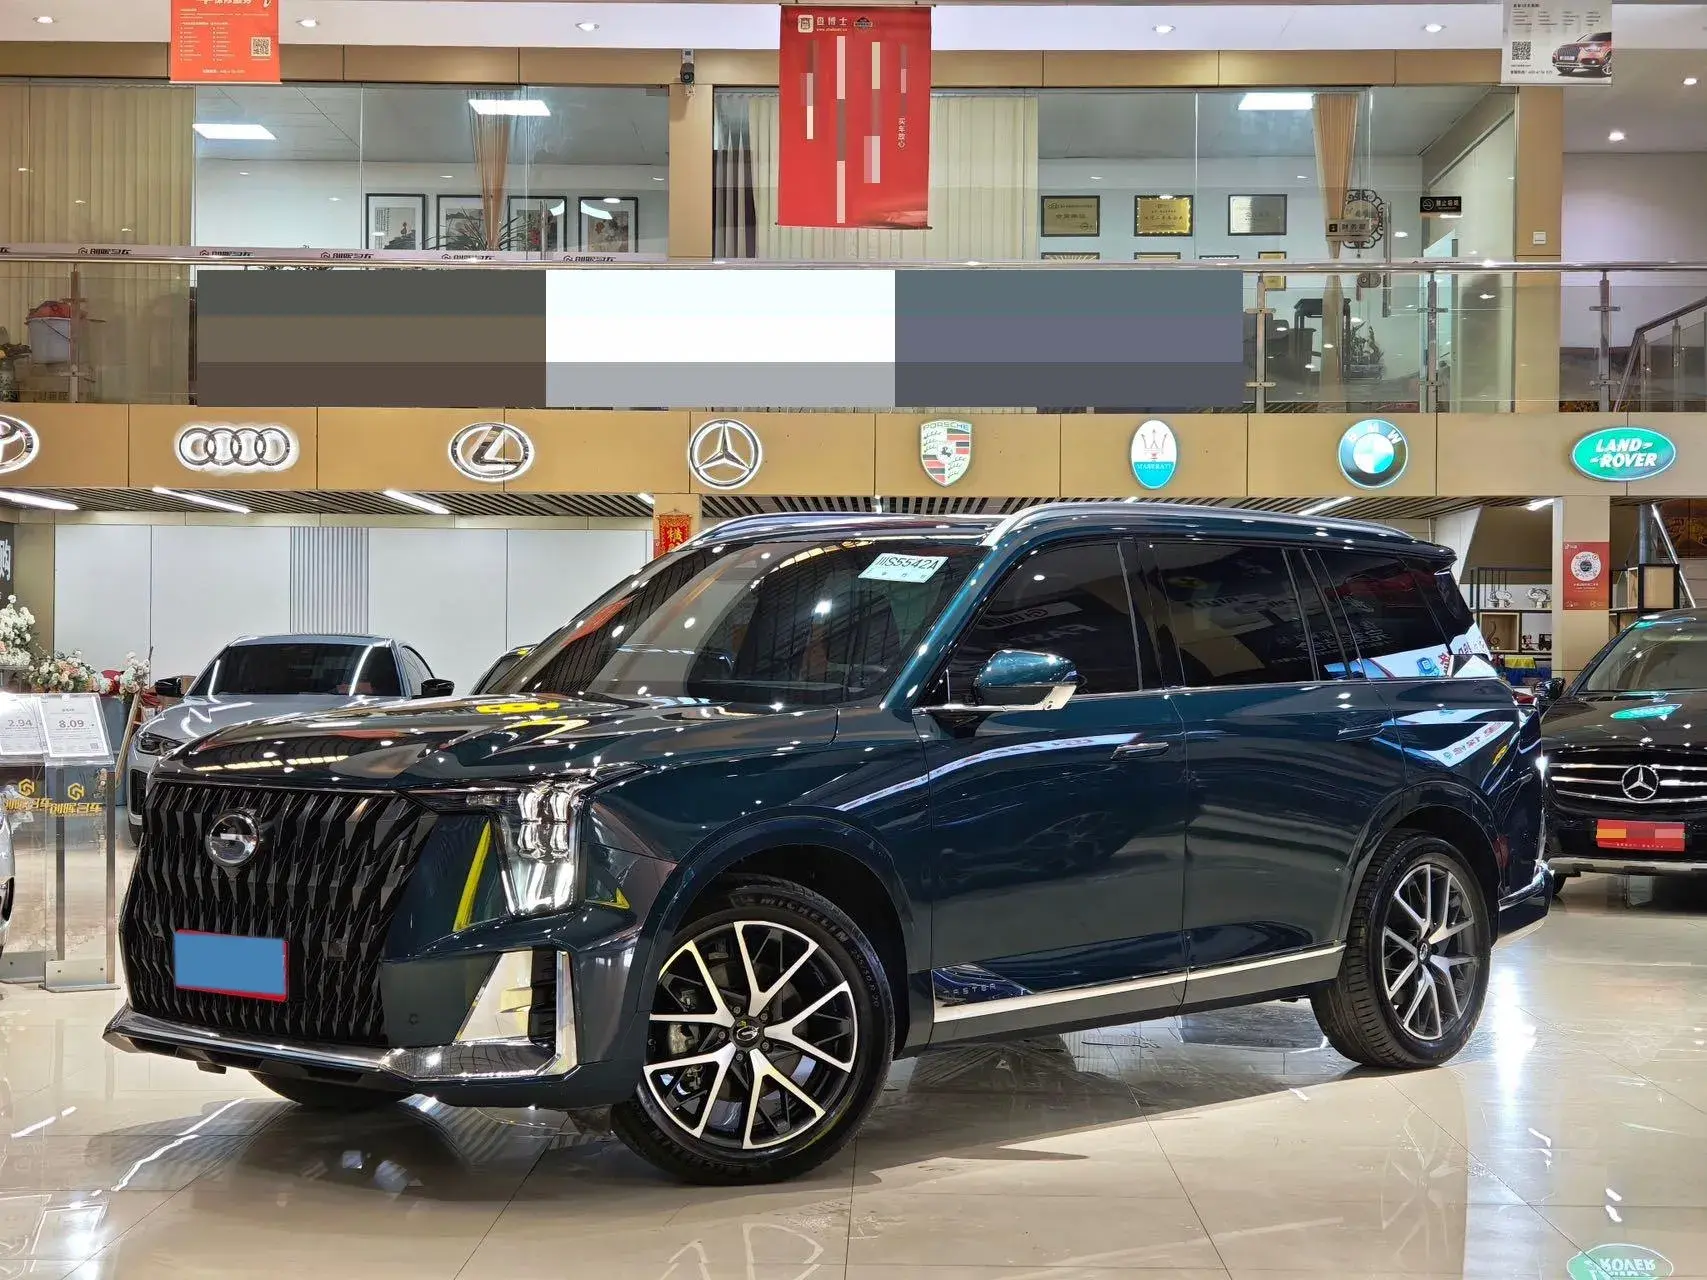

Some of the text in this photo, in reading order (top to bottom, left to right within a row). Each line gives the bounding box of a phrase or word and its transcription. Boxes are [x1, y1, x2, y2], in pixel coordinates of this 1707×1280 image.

[923, 421, 969, 431] PORSCHE
[1347, 423, 1403, 445] BMW
[760, 896, 850, 943] MICHELIN
